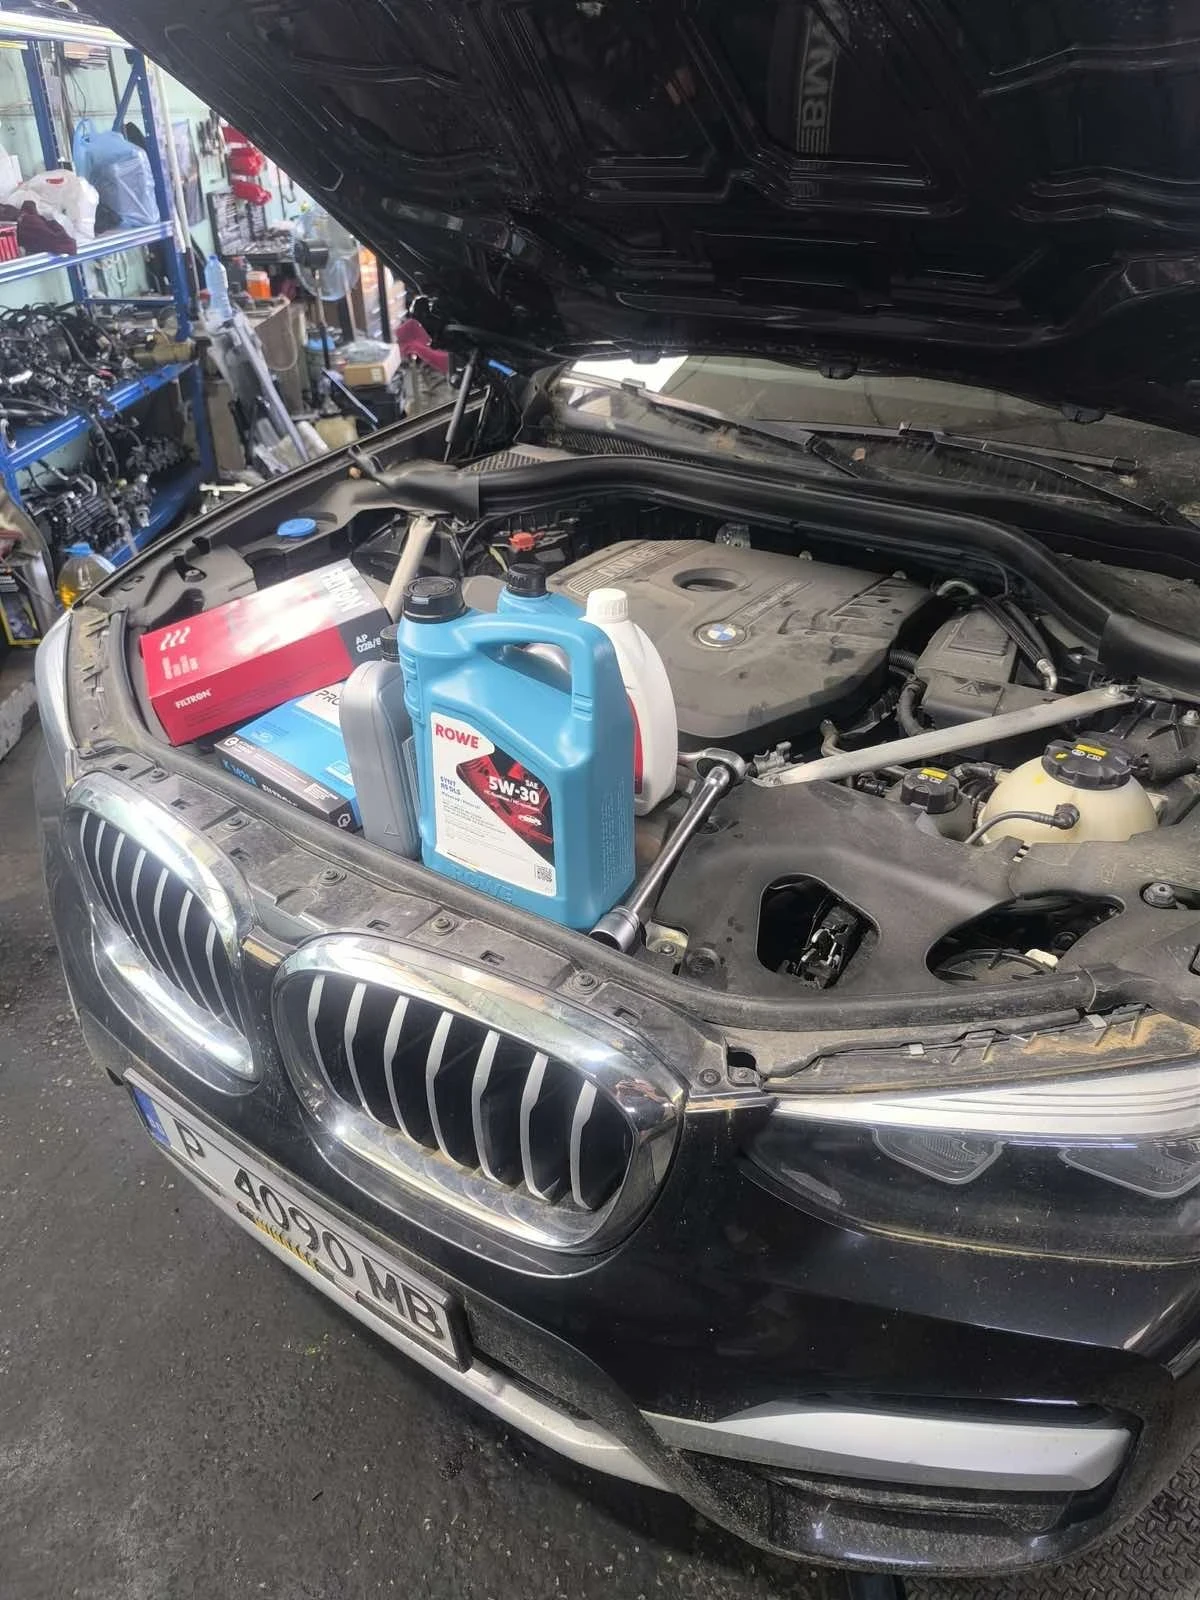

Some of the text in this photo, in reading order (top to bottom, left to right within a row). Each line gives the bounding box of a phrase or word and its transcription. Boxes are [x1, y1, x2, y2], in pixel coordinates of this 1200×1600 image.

[355, 633, 368, 645] AP
[175, 688, 211, 710] FILTRON
[435, 722, 479, 750] ROWE
[488, 775, 540, 805] 5W-30
[525, 778, 539, 790] SAE
